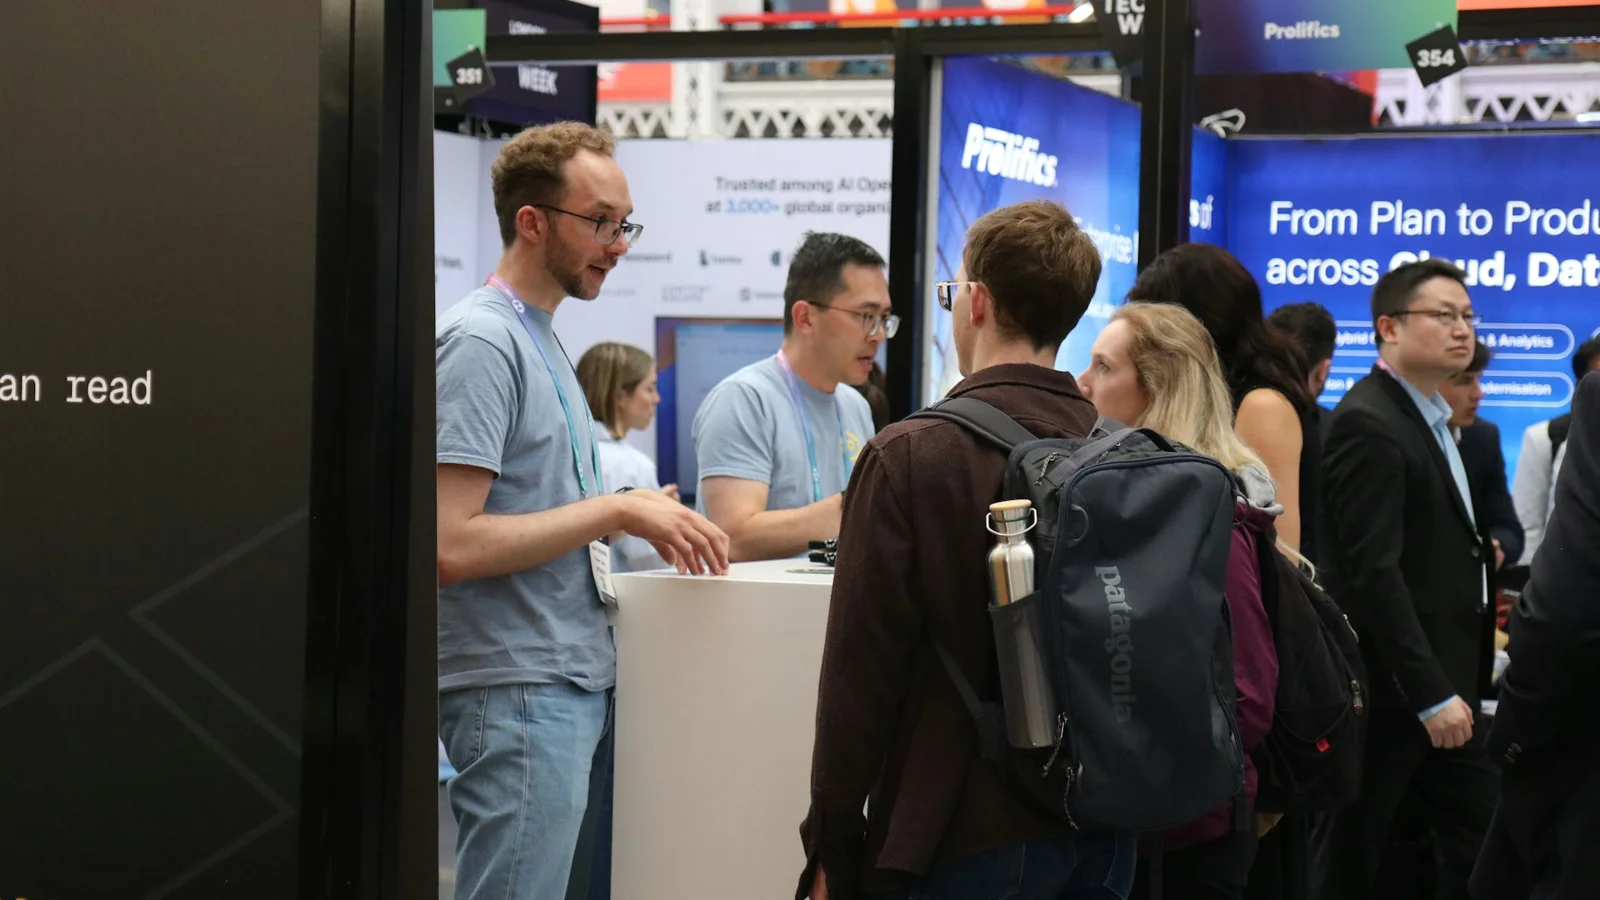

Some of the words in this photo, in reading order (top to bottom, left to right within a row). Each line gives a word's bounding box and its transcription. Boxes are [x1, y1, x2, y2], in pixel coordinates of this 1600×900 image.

[1264, 20, 1341, 40] Prolifics
[1417, 48, 1456, 67] 354
[456, 67, 483, 85] 351
[518, 65, 558, 96] WEEK
[961, 122, 1058, 188] Prolifics
[716, 177, 776, 192] Trusted
[780, 179, 833, 195] among
[838, 177, 854, 191] AI
[705, 200, 722, 214] at
[784, 199, 833, 218] global
[1200, 194, 1214, 231] of
[1269, 200, 1358, 235] From
[1370, 199, 1446, 235] Plan
[1457, 202, 1493, 235] to
[1265, 257, 1380, 286] across
[1388, 250, 1516, 292] ud,
[1486, 333, 1497, 348] &
[1498, 333, 1554, 351] Analytics
[0, 373, 41, 401] an
[66, 369, 152, 405] read
[1095, 565, 1137, 723] patagonia
